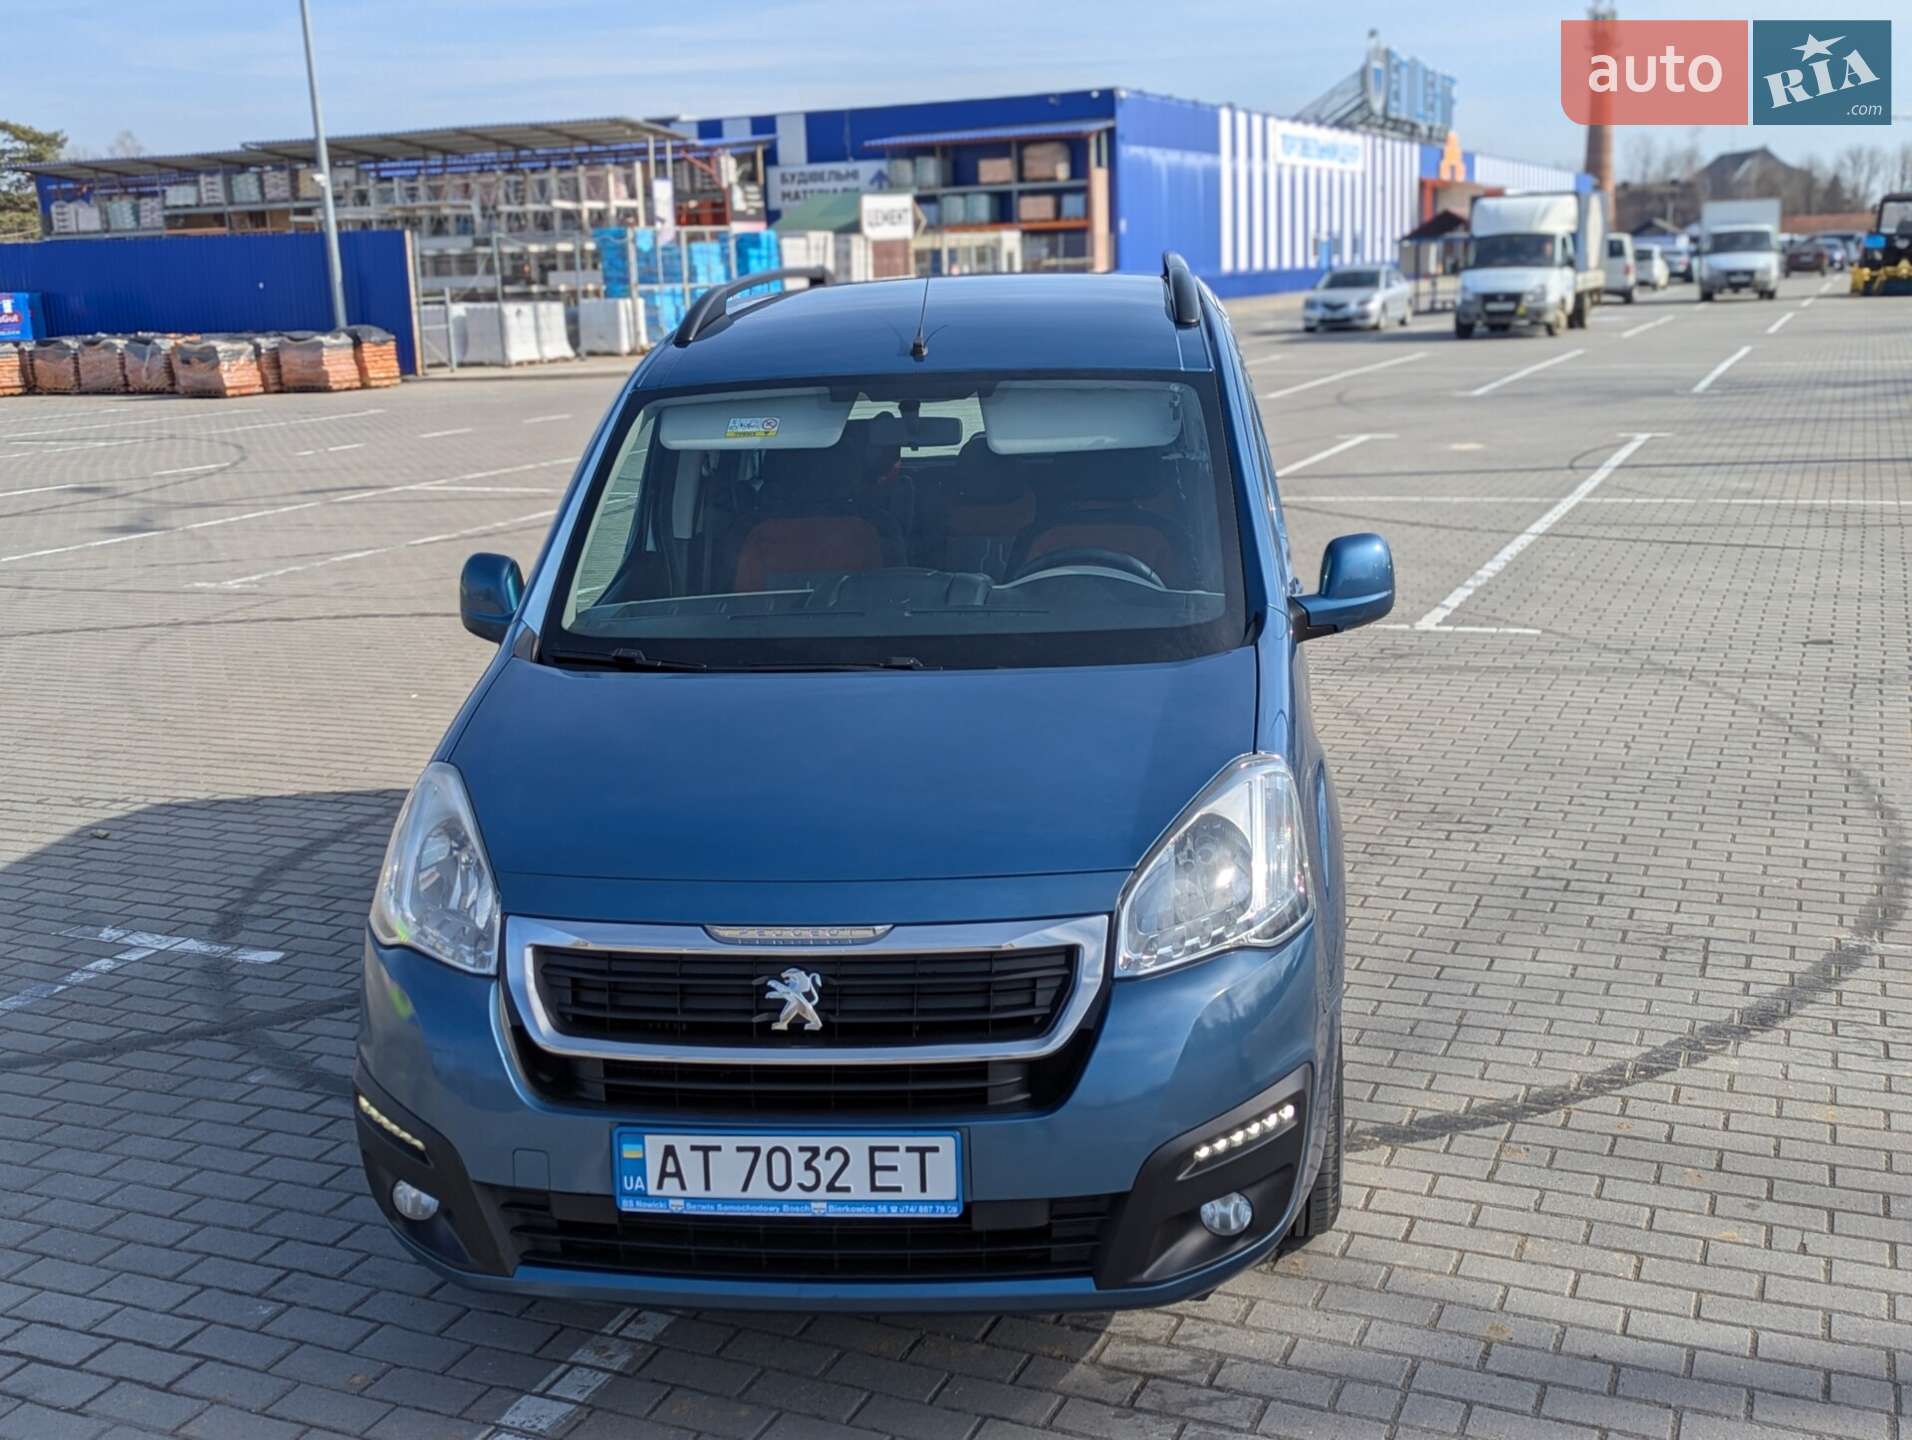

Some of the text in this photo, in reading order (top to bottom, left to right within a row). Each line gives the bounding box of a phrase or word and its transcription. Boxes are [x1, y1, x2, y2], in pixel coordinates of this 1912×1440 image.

[623, 1175, 645, 1190] UA
[656, 1144, 940, 1193] AT 7032 ET
